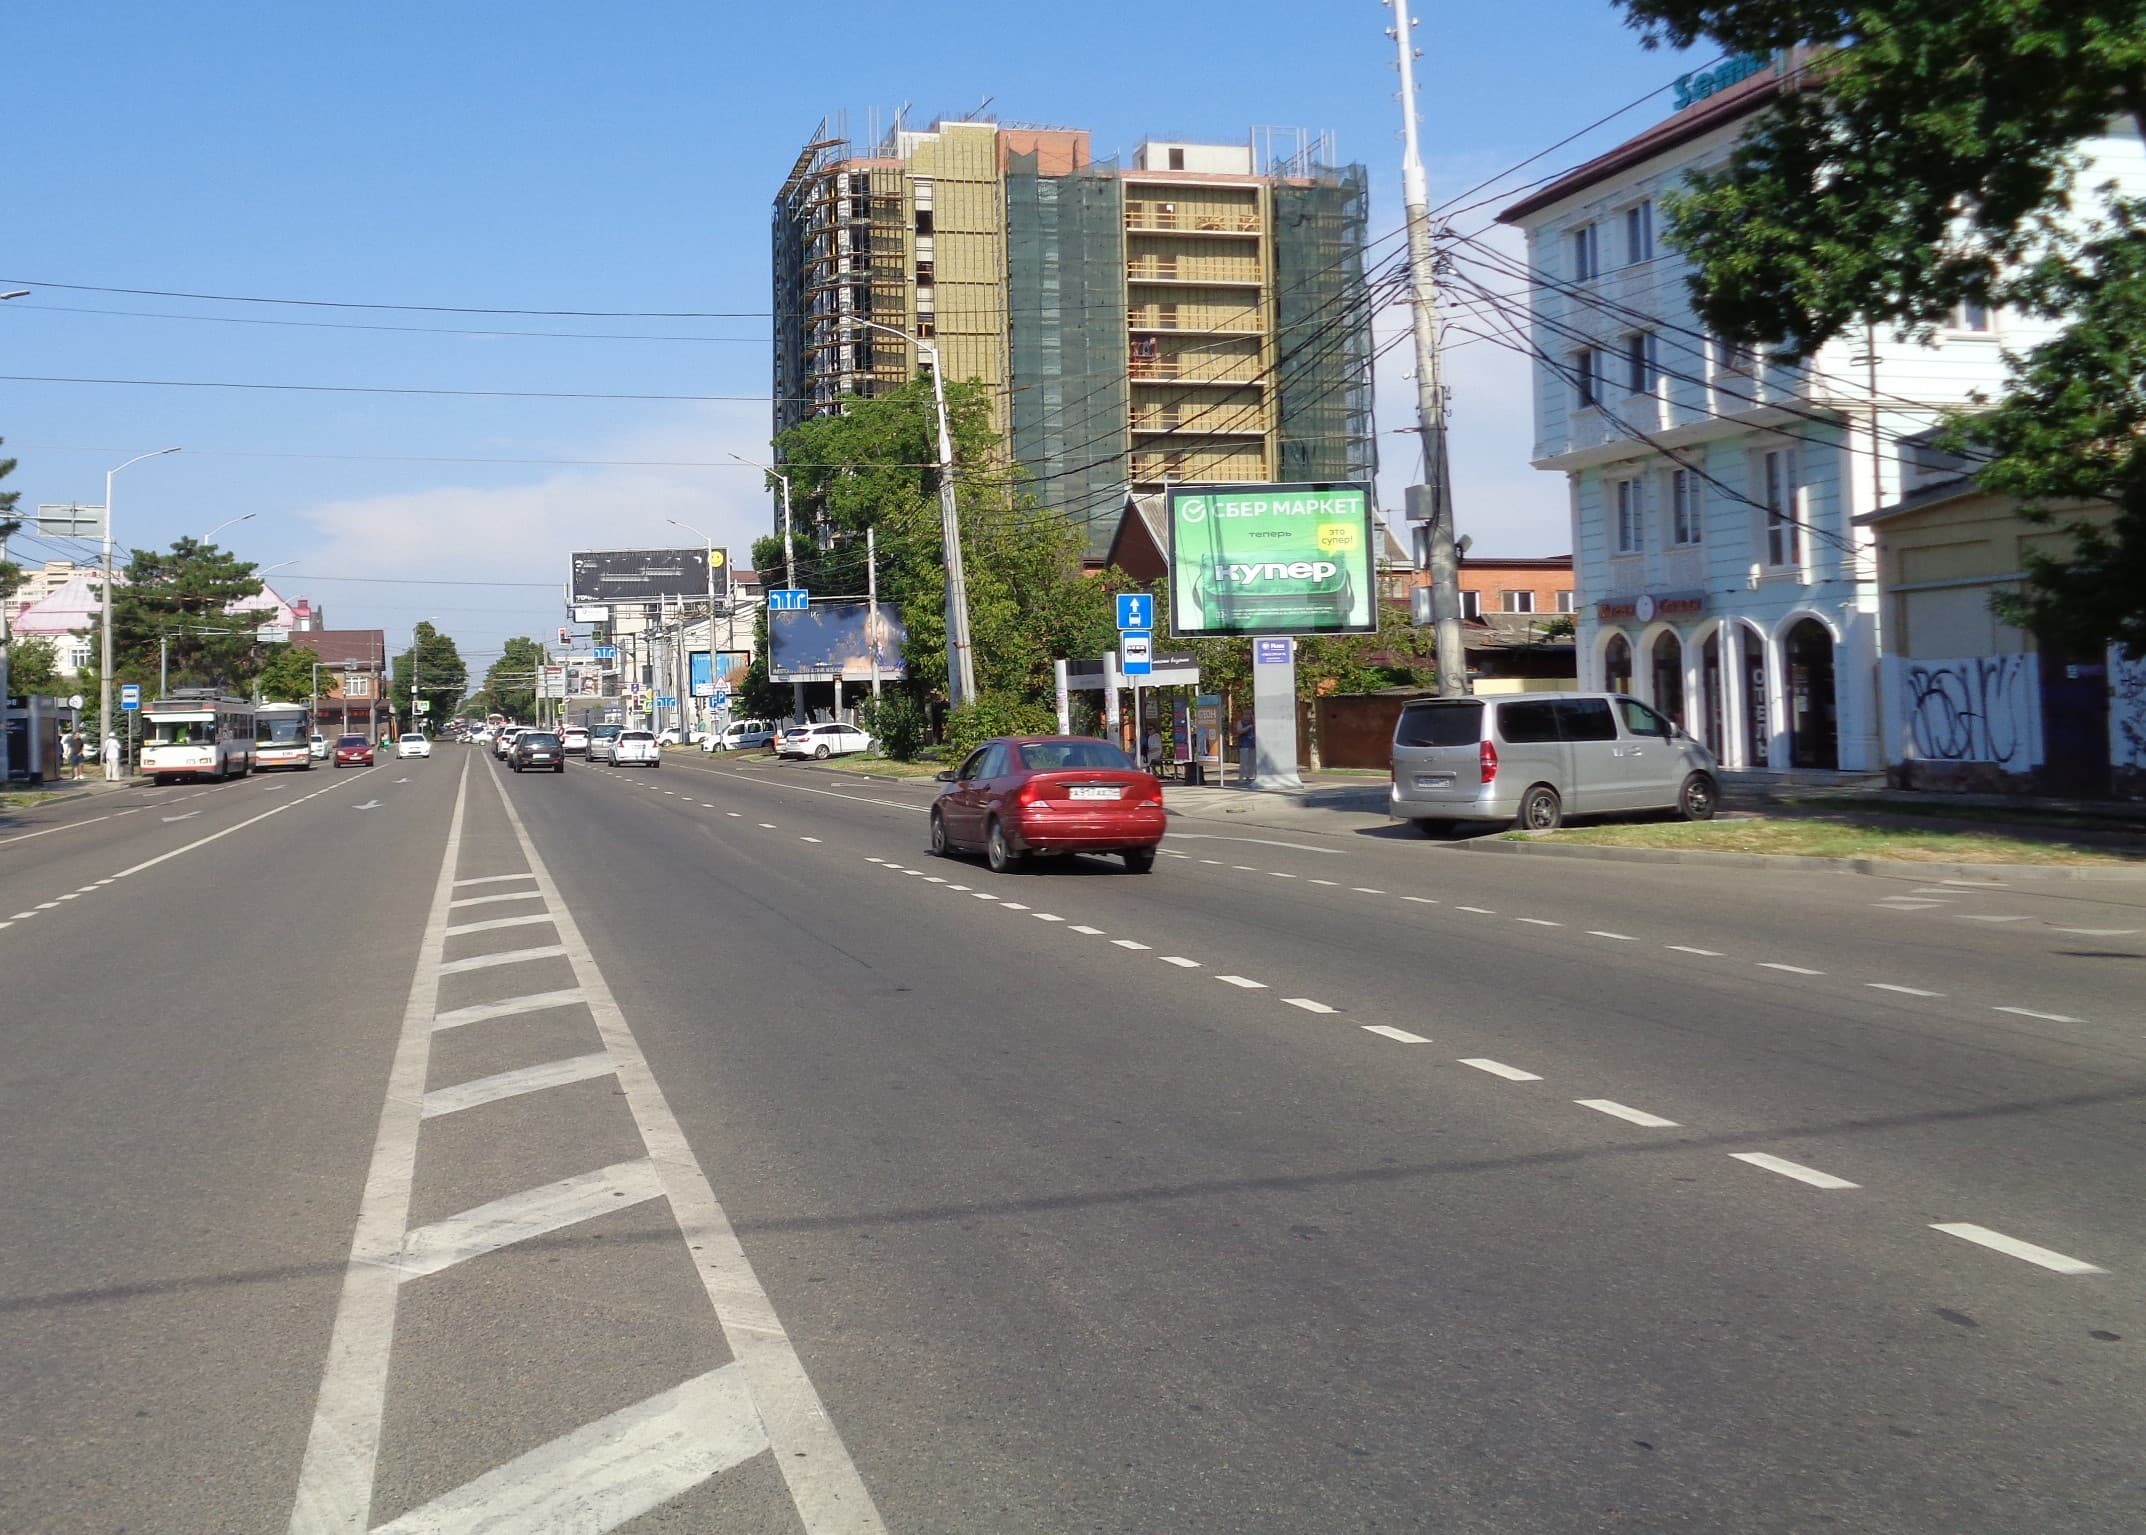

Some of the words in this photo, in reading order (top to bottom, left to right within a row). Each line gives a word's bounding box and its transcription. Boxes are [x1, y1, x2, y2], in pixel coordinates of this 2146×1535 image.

[1212, 501, 1268, 518] СБЕР
[1272, 498, 1361, 516] МАРКЕТ
[1248, 531, 1293, 539] теперь
[1328, 528, 1346, 536] это
[1321, 535, 1353, 545] супер!
[1215, 561, 1337, 585] купер
